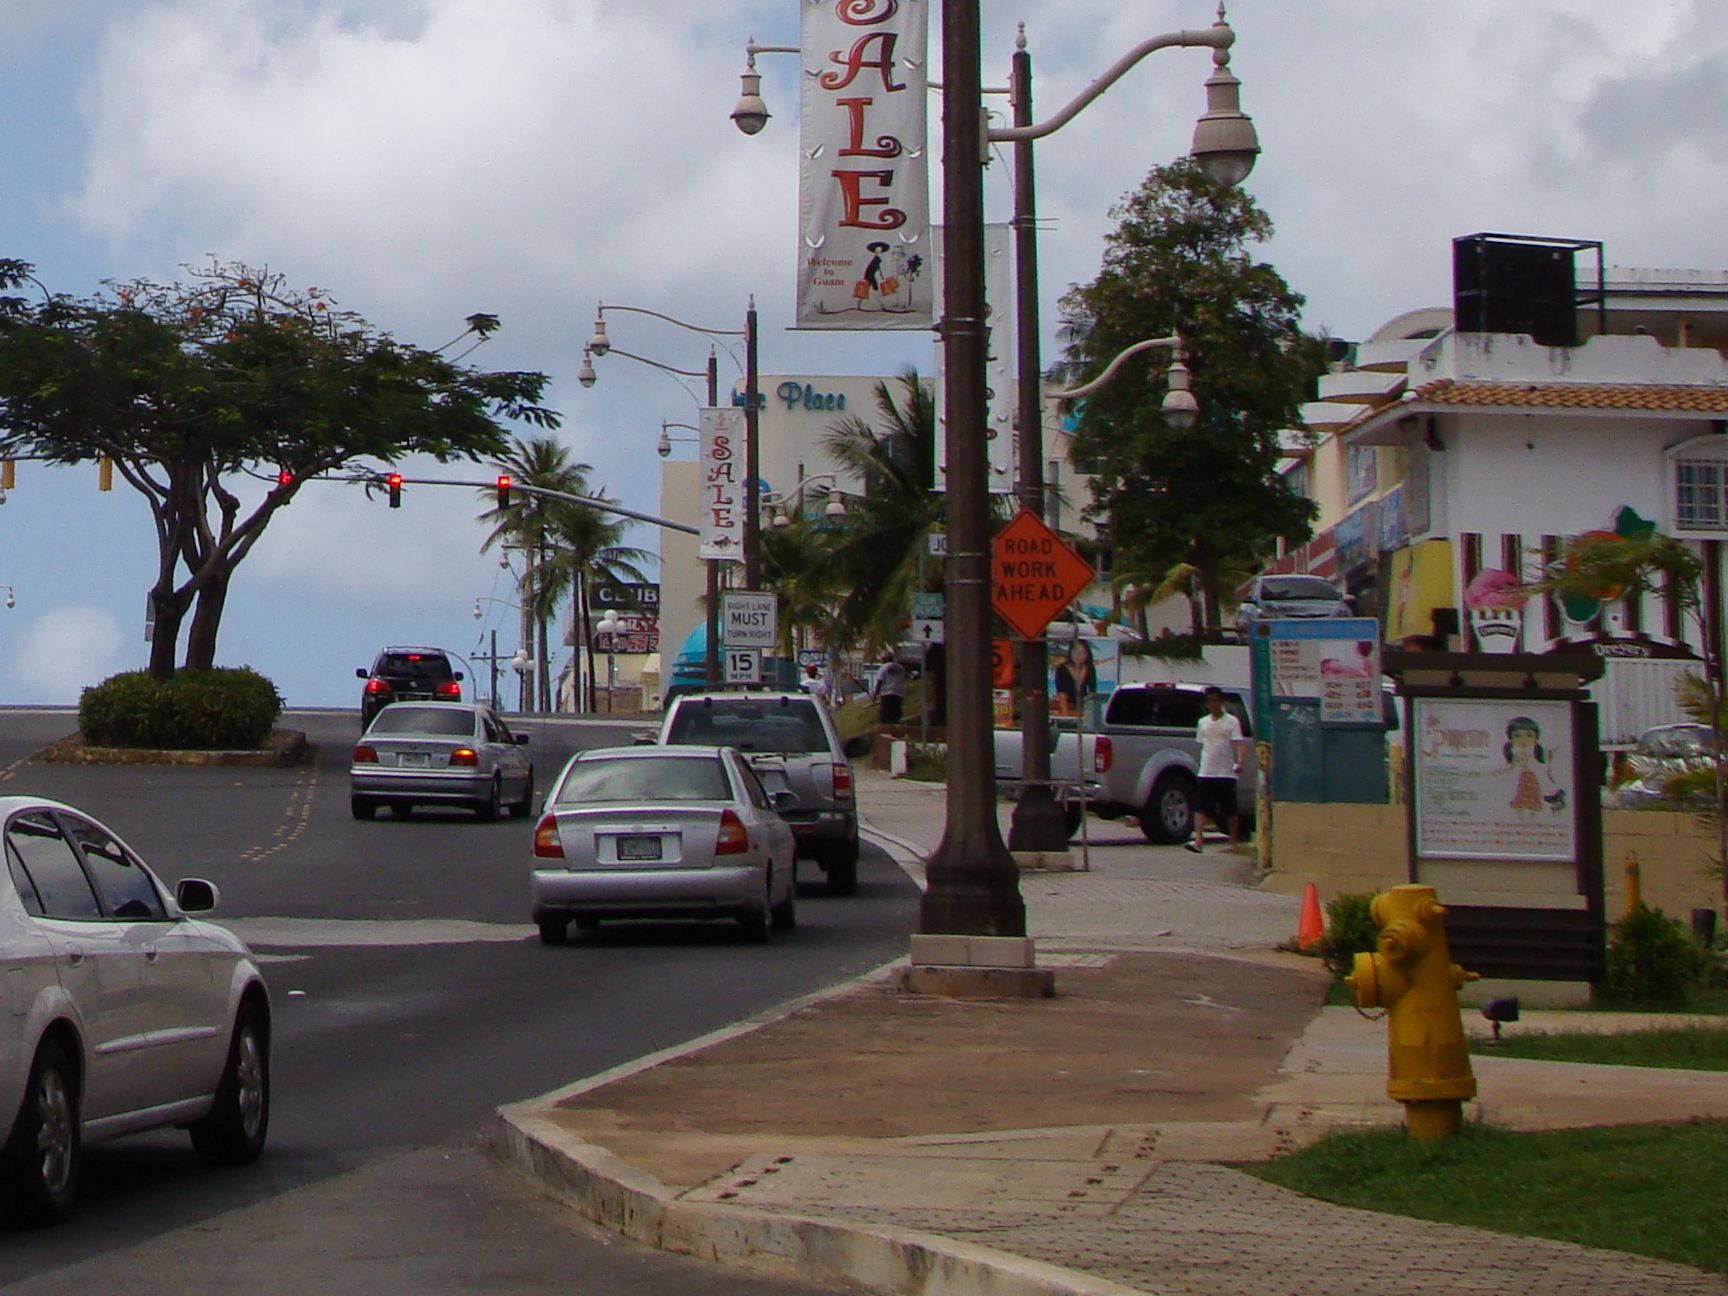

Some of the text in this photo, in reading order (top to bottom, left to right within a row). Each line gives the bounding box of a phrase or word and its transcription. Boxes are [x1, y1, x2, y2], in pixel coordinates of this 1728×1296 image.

[807, 257, 853, 267] Welcome
[823, 268, 834, 276] to
[813, 278, 845, 286] Guam
[777, 381, 846, 411] Place
[707, 435, 735, 528] SALE
[1005, 538, 1052, 554] ROAD
[1002, 561, 1056, 578] WORK
[997, 584, 1064, 601] AHEAD
[731, 612, 768, 625] MUST
[728, 630, 771, 638] TURN RIGHT
[730, 653, 752, 671] 15
